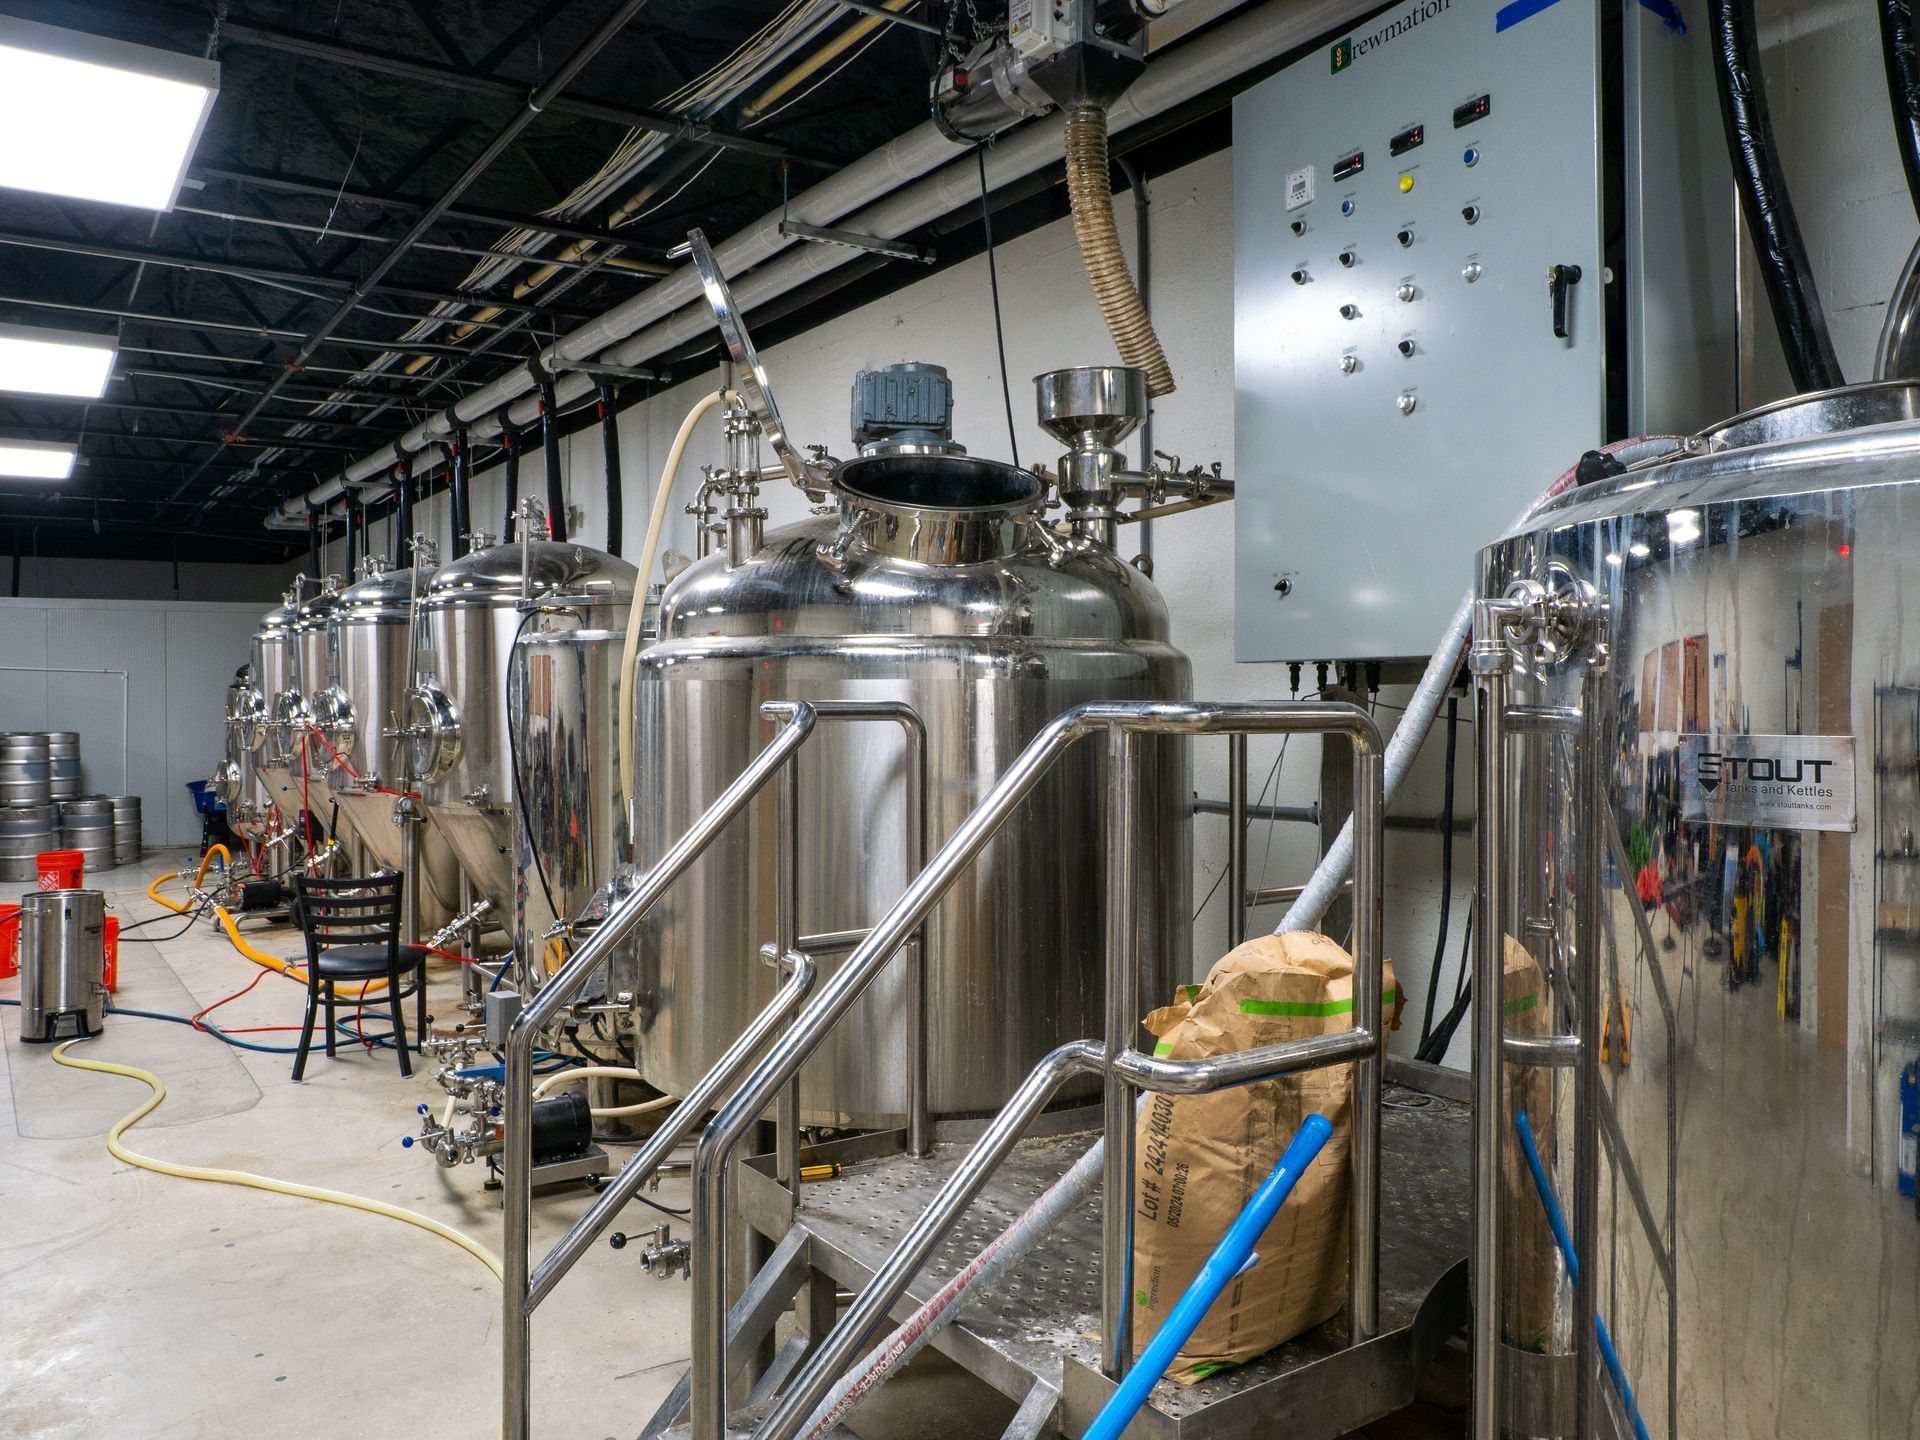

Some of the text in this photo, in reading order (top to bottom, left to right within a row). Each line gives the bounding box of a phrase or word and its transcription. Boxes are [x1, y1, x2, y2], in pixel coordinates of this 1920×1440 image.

[1698, 753, 1832, 790] STOUT
[1725, 783, 1833, 798] Tanks and Kettles
[1759, 801, 1832, 811] www.stouttanks.com
[1137, 1192, 1160, 1222] Lot
